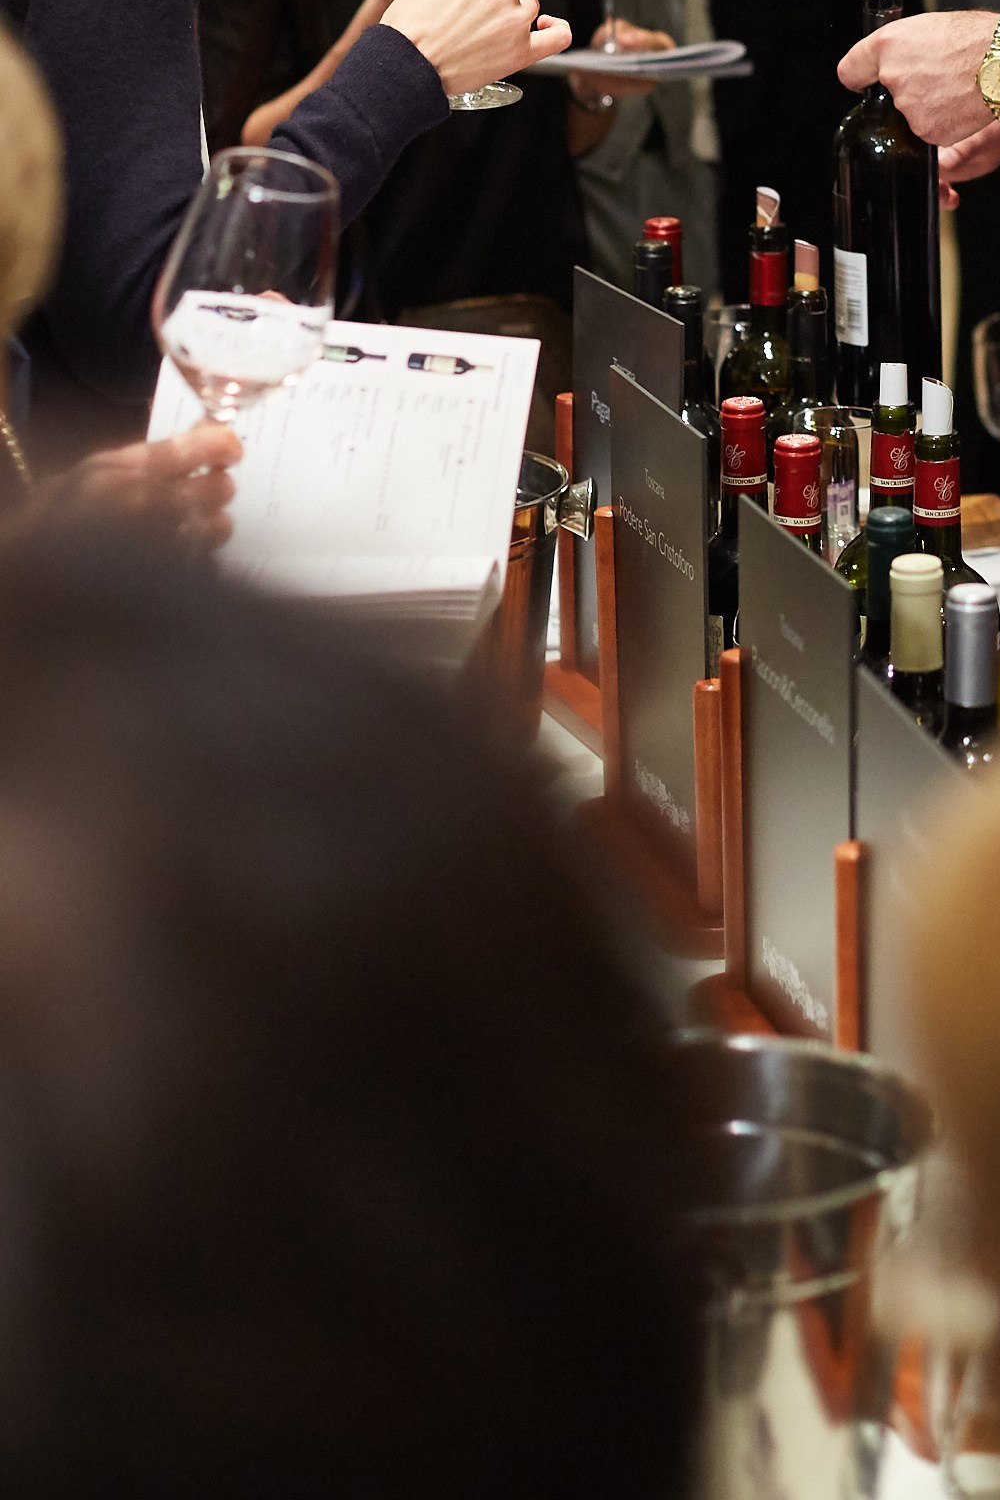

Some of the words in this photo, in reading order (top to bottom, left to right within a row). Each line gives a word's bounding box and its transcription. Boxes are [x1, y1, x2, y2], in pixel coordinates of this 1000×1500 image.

[591, 390, 611, 424] Paga
[644, 468, 665, 501] Toscana
[619, 496, 643, 537] Podere
[643, 517, 657, 550] San
[657, 532, 695, 581] Cristoforo
